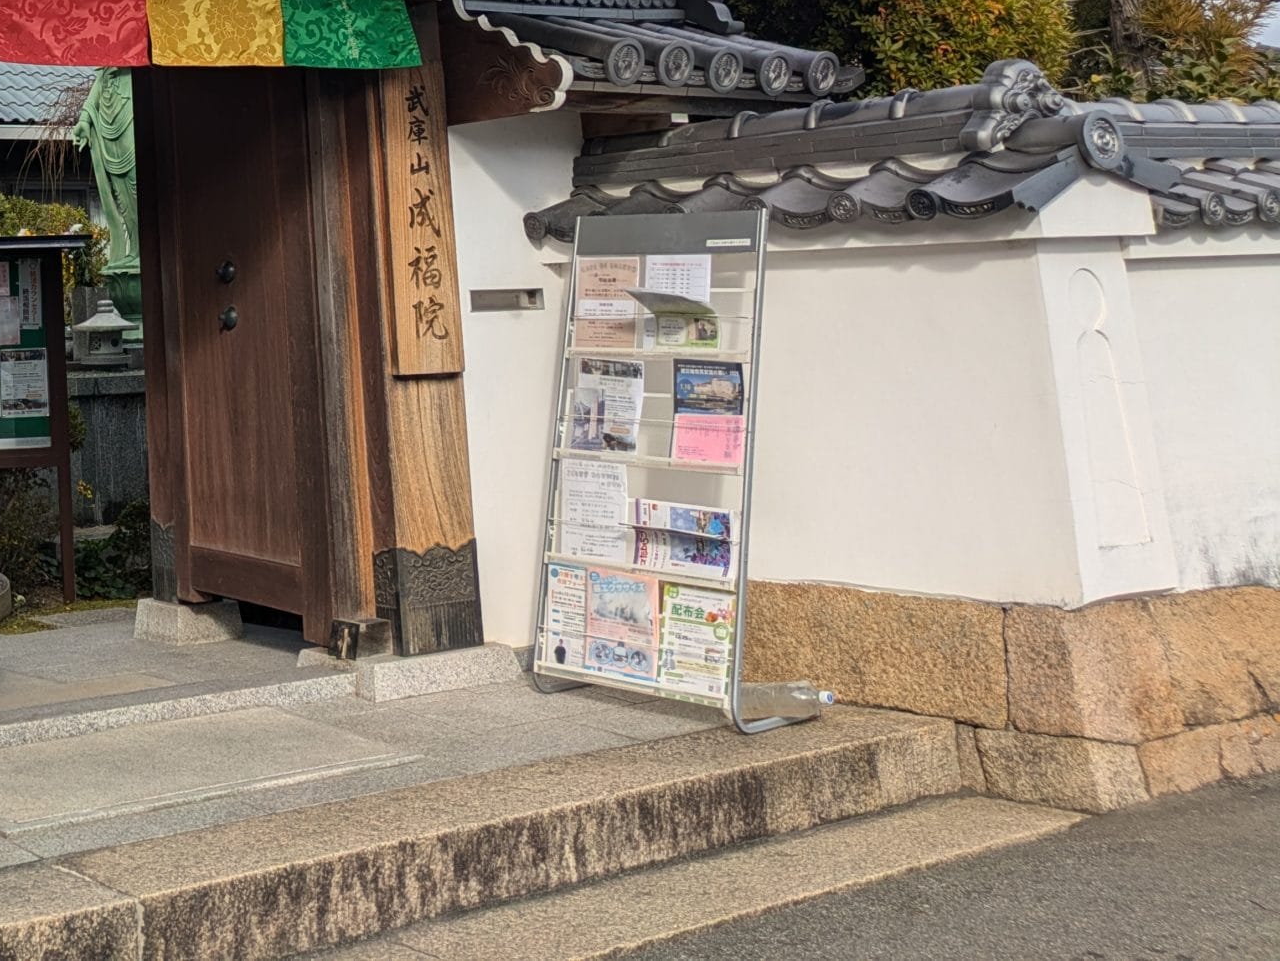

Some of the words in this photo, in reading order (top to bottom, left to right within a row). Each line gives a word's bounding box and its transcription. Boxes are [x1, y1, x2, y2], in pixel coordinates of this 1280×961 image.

[404, 85, 449, 340] 武庫山成福院
[671, 603, 706, 620] 配布会
